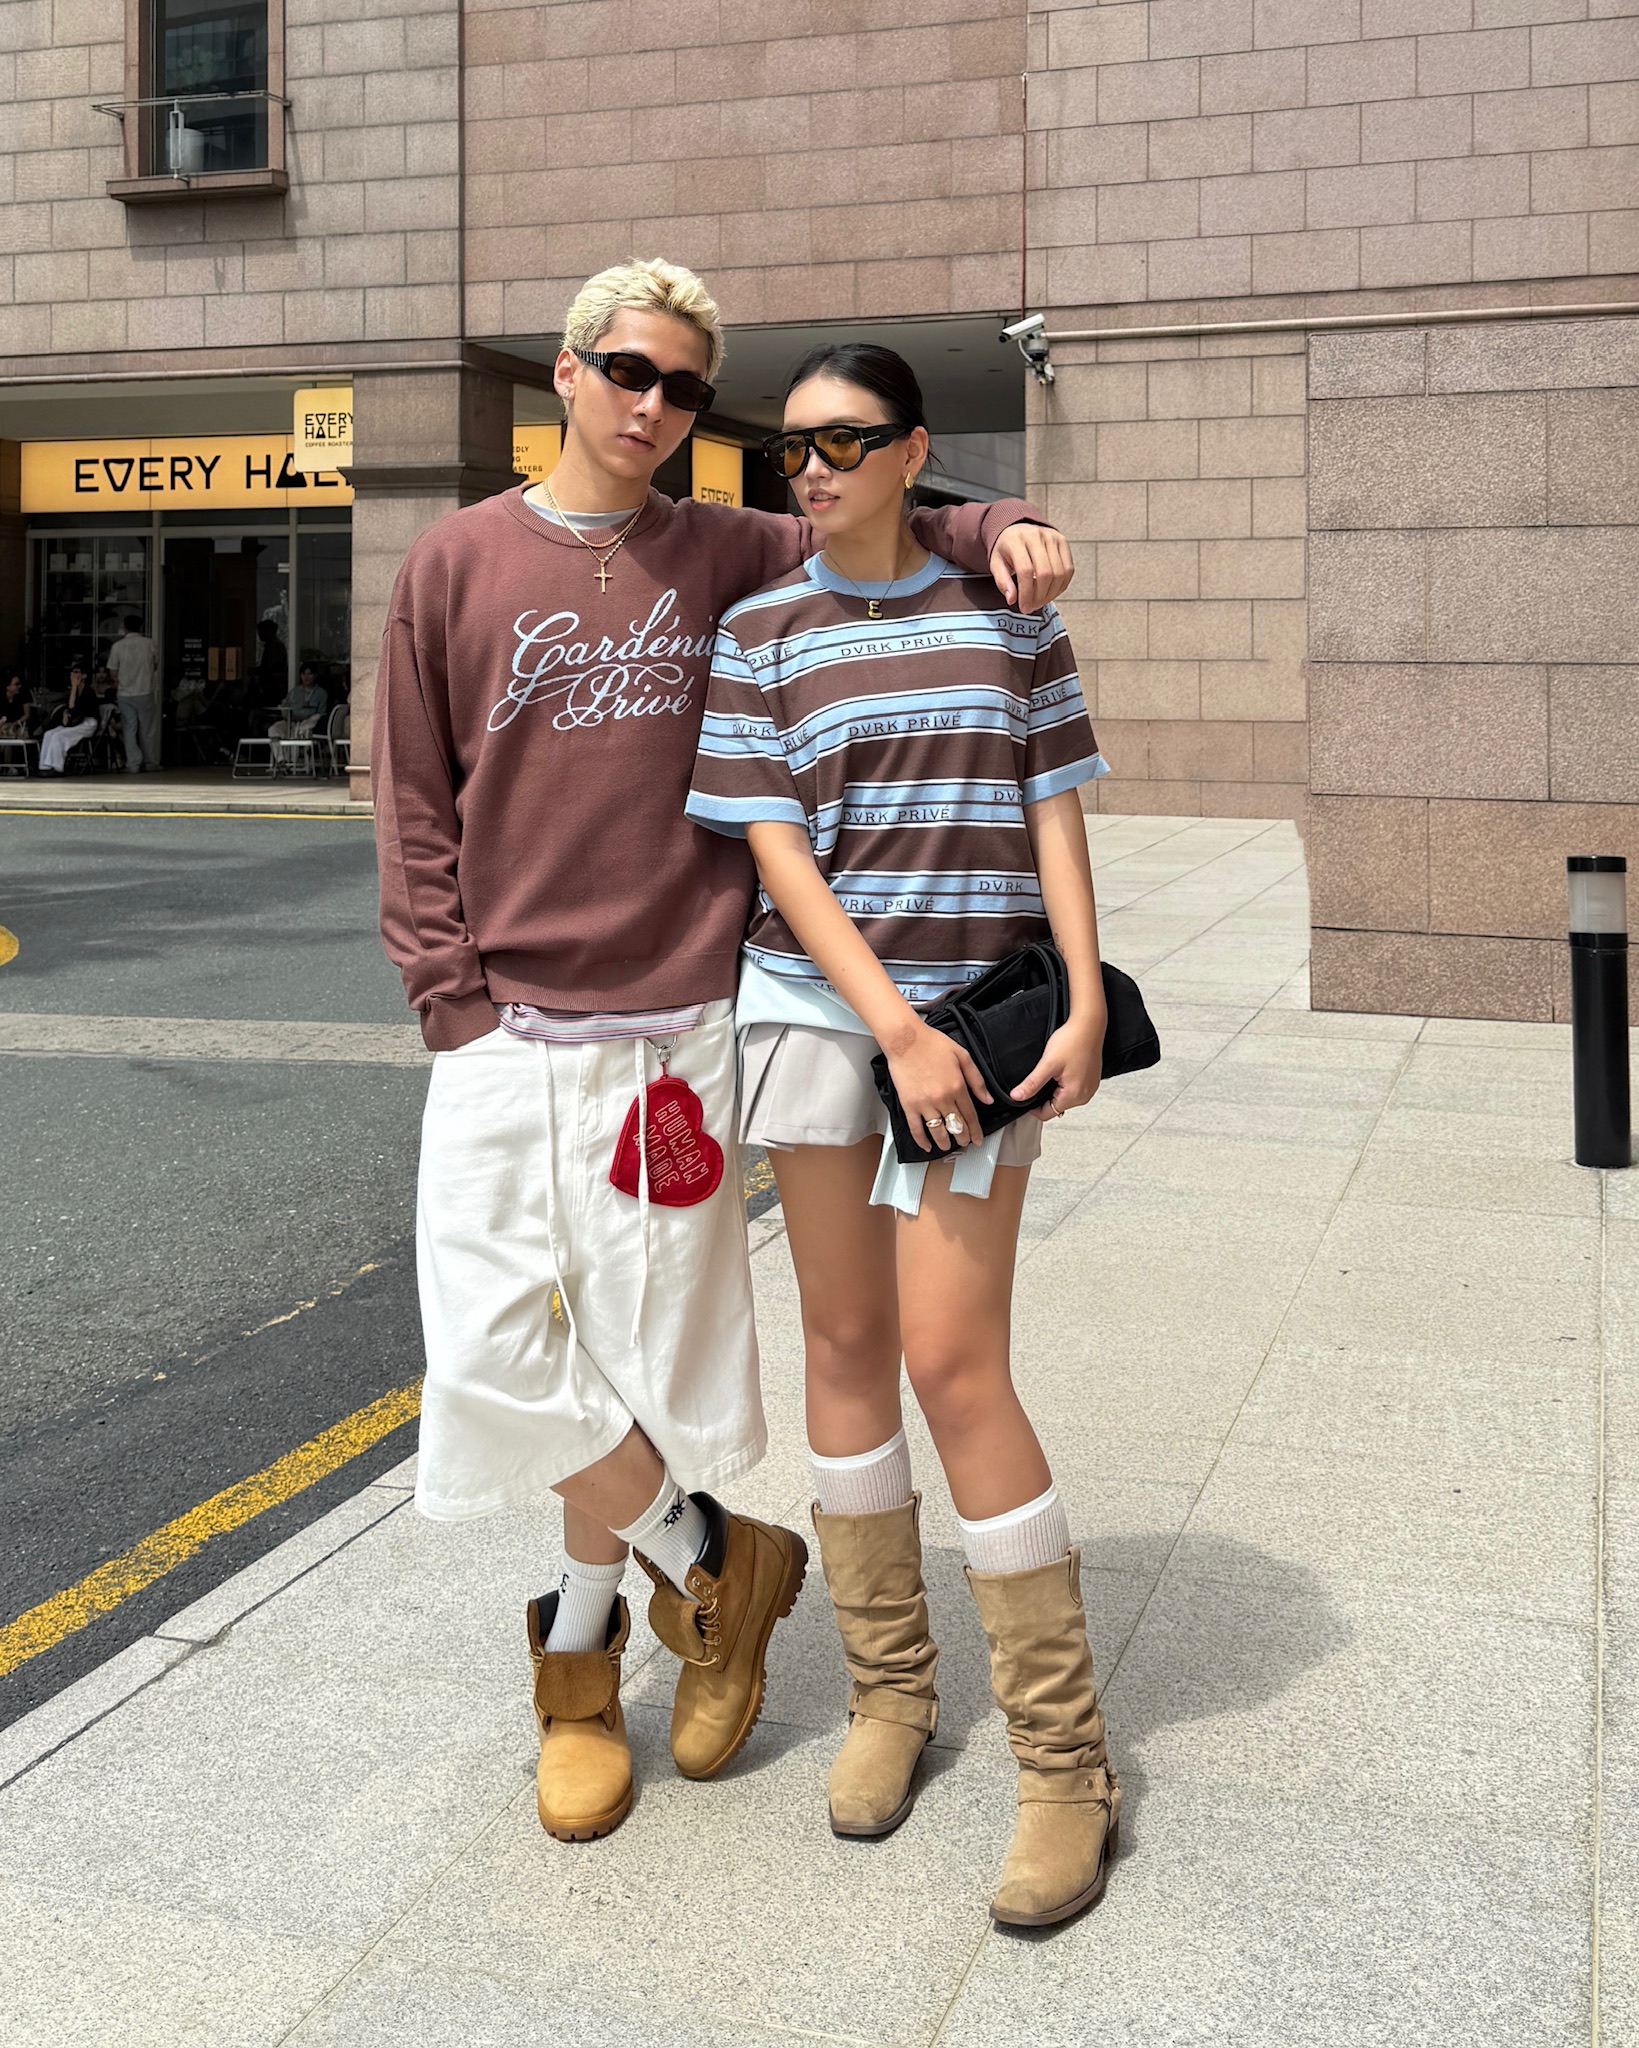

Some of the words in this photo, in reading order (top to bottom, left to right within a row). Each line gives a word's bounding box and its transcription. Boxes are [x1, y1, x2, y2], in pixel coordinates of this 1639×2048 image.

[305, 412, 353, 426] EVERY
[305, 425, 347, 440] HALF
[513, 445, 529, 453] DLY
[75, 455, 221, 492] EVERY
[246, 453, 351, 489] HAL
[996, 618, 1038, 634] DVRK
[841, 642, 892, 657] DVRK
[901, 632, 956, 649] PRIVÉ
[487, 588, 716, 732] Gardéni
[552, 662, 693, 731] Privé
[848, 720, 899, 737] DVRK
[907, 711, 962, 730] PRIVÉ
[783, 726, 811, 751] RIVÉ
[843, 811, 888, 823] DVRK
[898, 804, 951, 821] PRIVÉ
[979, 881, 1024, 892] DVRK
[840, 898, 874, 912] VRK
[883, 896, 935, 911] PRIVÉ
[654, 1099, 709, 1185] HUMAN
[632, 1124, 680, 1193] MADE
